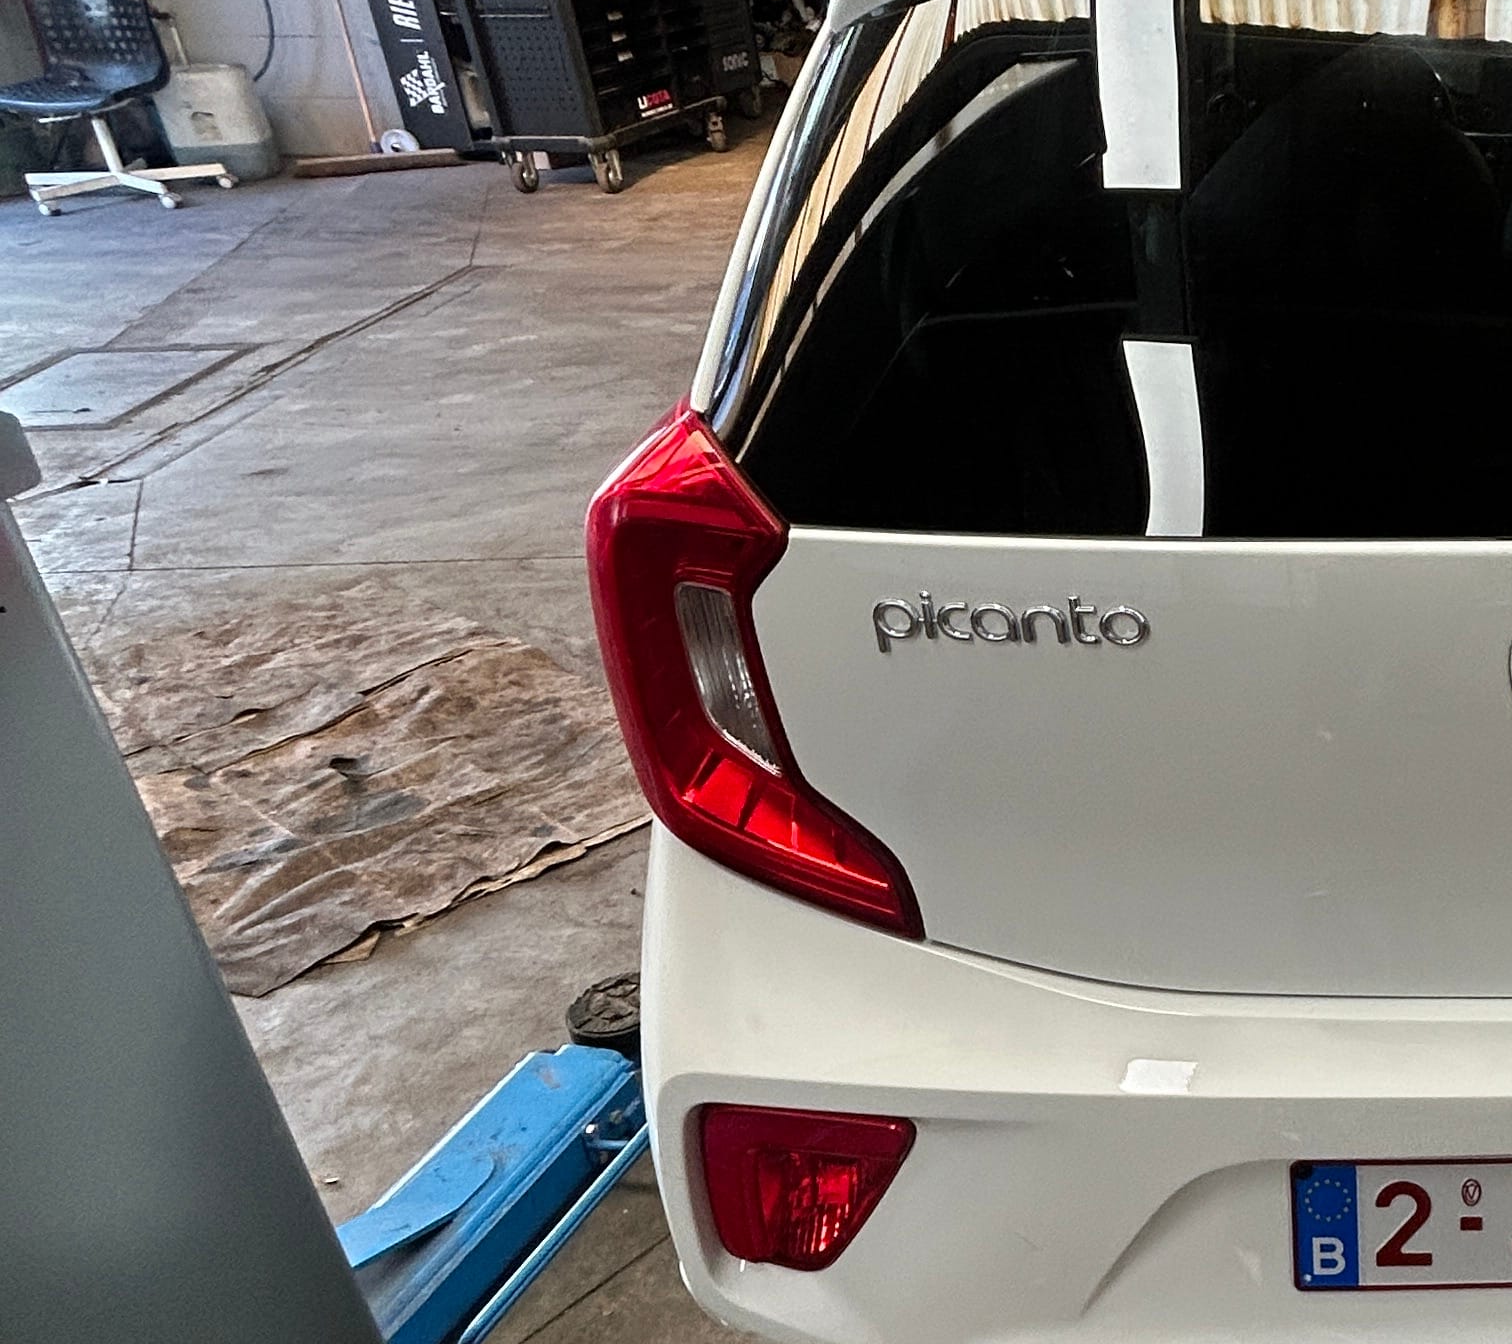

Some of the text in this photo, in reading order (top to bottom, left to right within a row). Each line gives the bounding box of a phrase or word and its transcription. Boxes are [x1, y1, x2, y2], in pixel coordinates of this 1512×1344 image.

[416, 50, 446, 114] BARDAHL
[873, 589, 1151, 653] picanto
[1311, 1236, 1346, 1276] B
